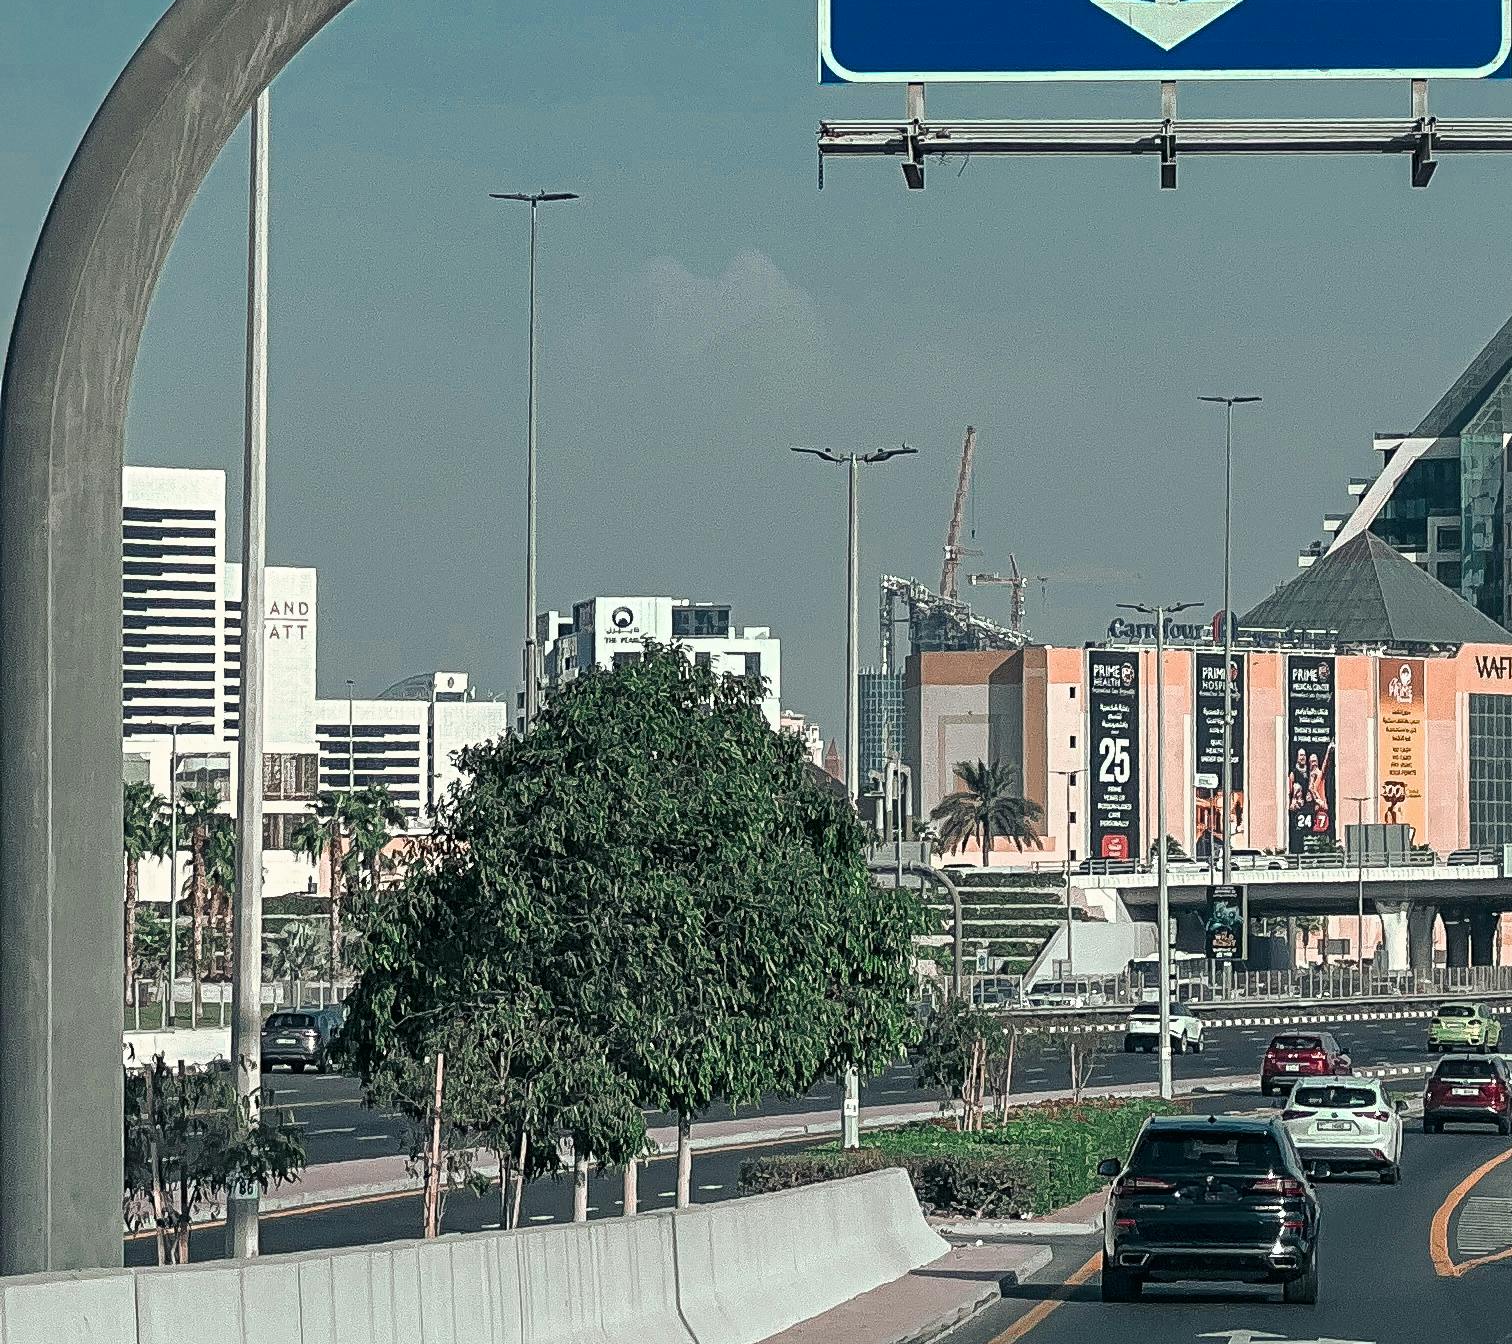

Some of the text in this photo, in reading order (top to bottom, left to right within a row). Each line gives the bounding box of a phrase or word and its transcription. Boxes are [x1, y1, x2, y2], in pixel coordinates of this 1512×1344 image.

[270, 601, 309, 615] AND
[264, 624, 307, 639] ATT
[1108, 617, 1204, 639] Carrfour
[1094, 664, 1120, 677] PRIME
[1202, 667, 1225, 680] PRIM
[1475, 656, 1512, 679] WAFI
[1292, 668, 1318, 682] PRIME
[1094, 678, 1121, 687] HEALTH
[1202, 681, 1238, 691] HOSPIAL
[1099, 738, 1130, 783] 25
[1297, 814, 1312, 827] 24
